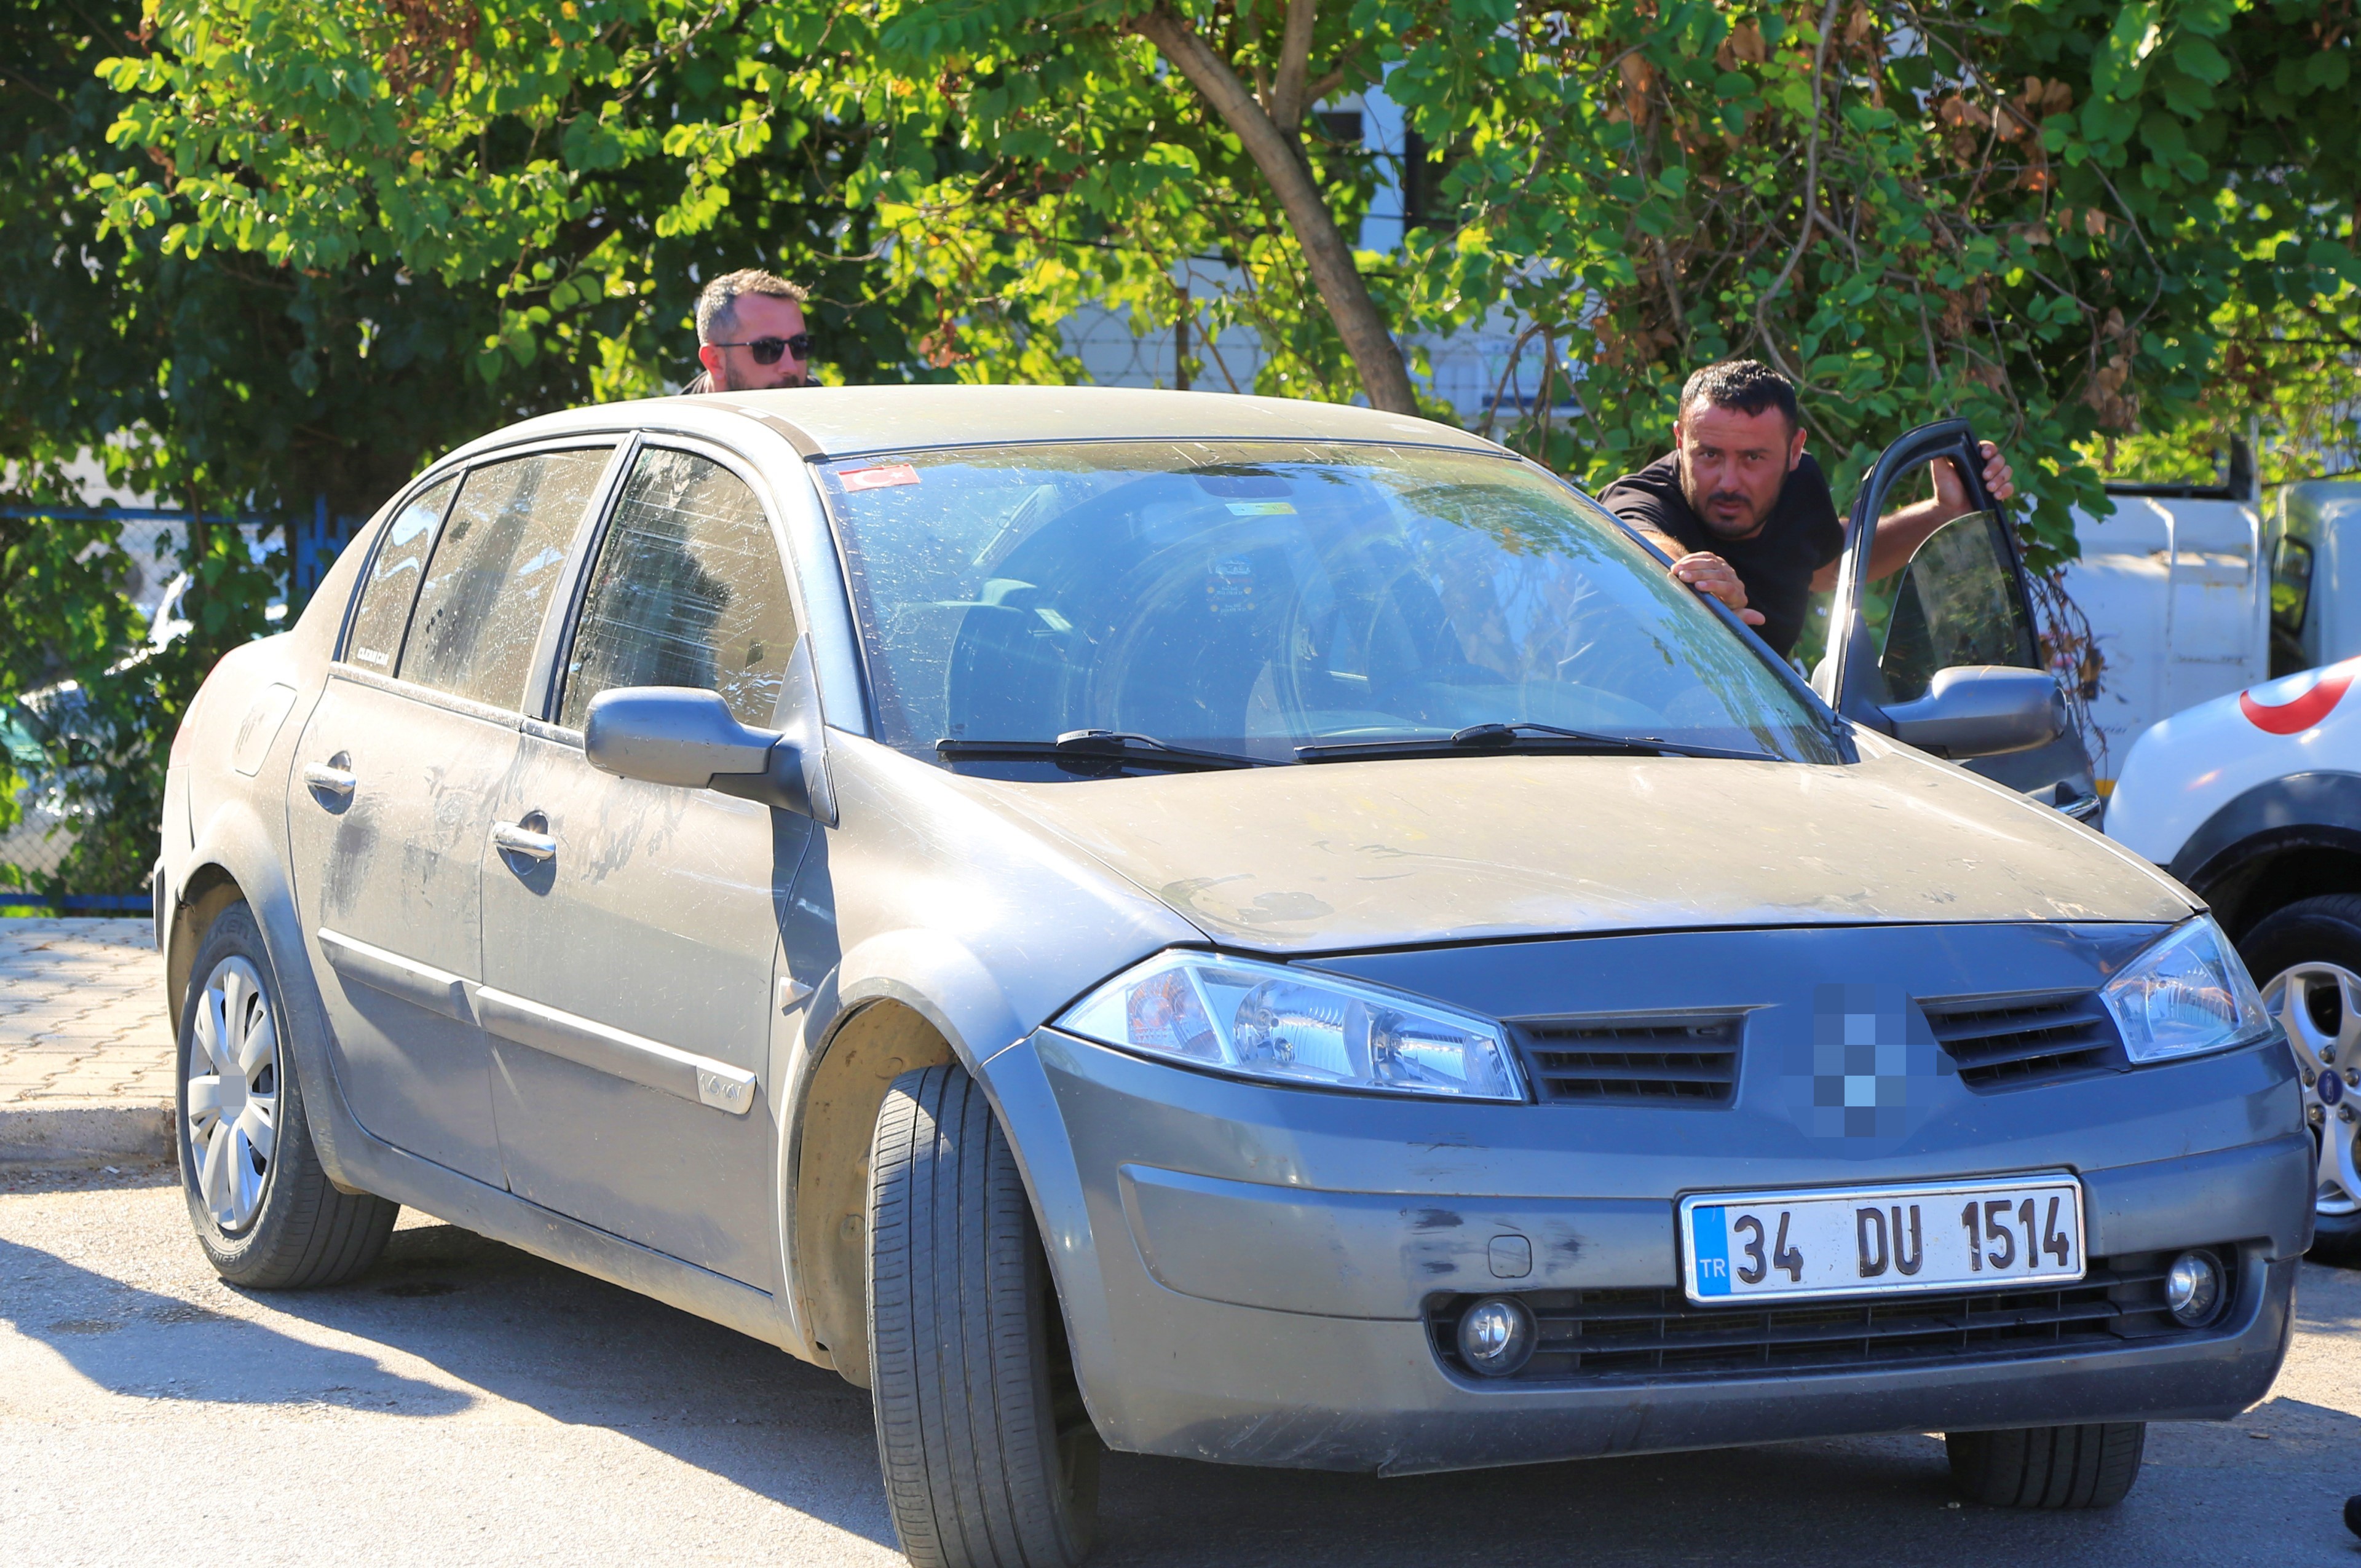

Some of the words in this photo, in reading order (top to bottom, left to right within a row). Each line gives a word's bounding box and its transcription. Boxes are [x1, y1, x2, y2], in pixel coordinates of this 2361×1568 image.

[357, 647, 378, 663] CLEAN
[376, 652, 389, 666] CAR
[1734, 1211, 1804, 1284] 34
[1856, 1205, 1923, 1278] DU
[1961, 1196, 2070, 1272] 1514
[1699, 1258, 1726, 1278] TR
